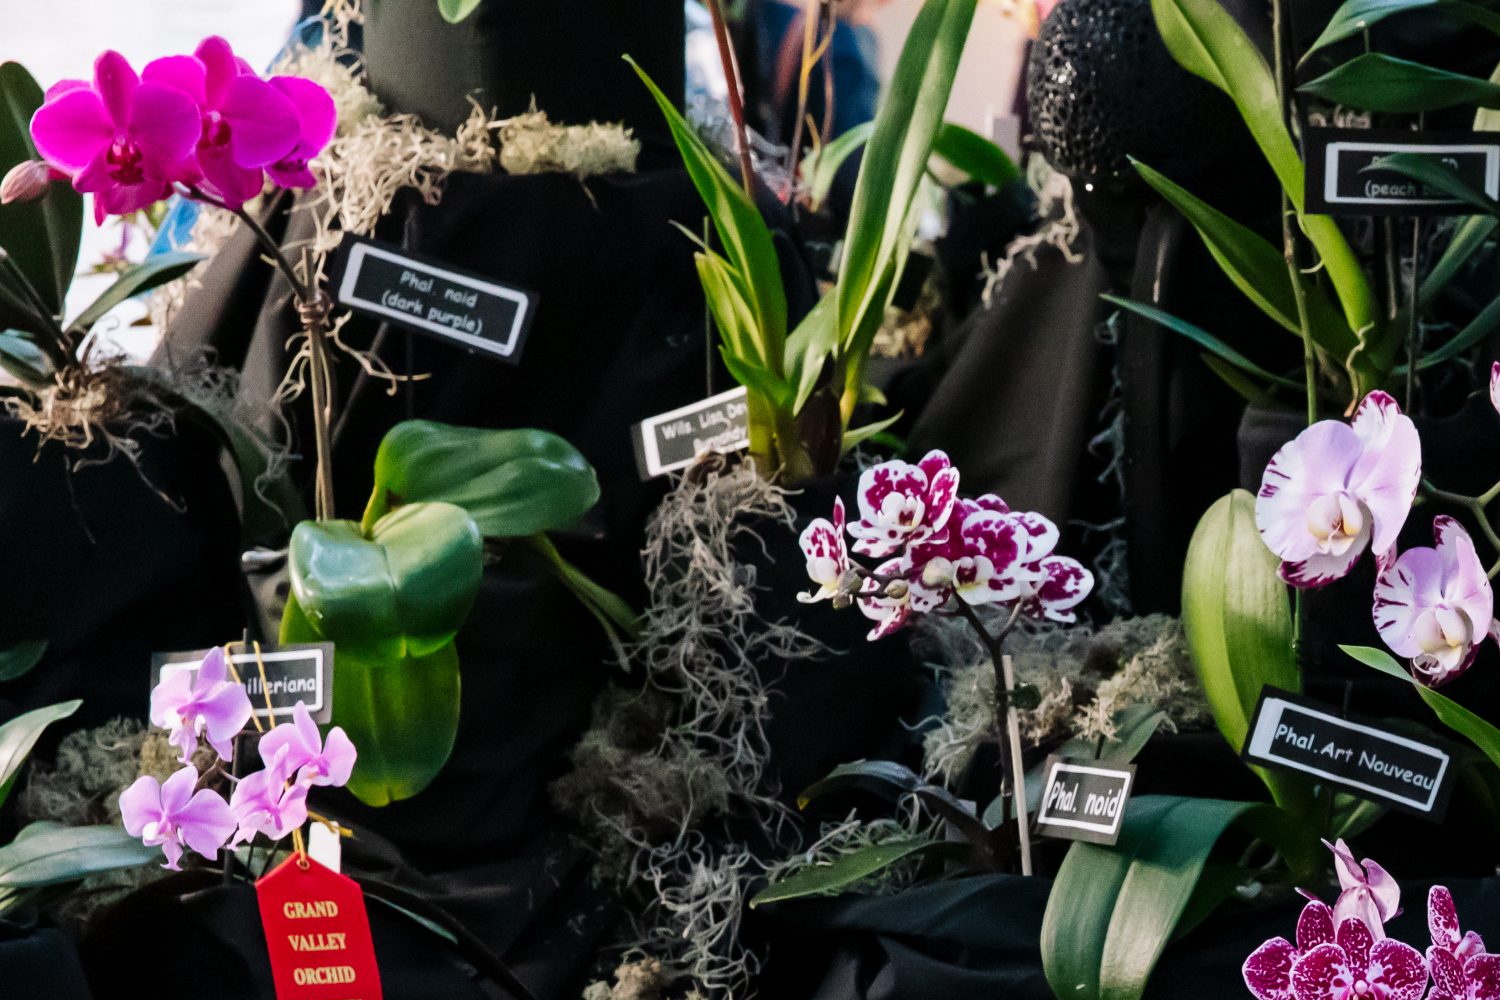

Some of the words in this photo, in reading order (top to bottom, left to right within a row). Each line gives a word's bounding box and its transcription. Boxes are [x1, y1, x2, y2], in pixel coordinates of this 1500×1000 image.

[1365, 179, 1416, 197] (peach
[400, 271, 437, 296] Phal.
[382, 289, 424, 316] (dark
[428, 306, 483, 336] purple)
[1358, 750, 1435, 791] Nouveau
[1048, 781, 1079, 813] Phal.
[1084, 788, 1122, 818] noid
[283, 900, 339, 919] GRAND
[287, 932, 346, 952] VALLEY
[293, 965, 356, 986] ORCHID
